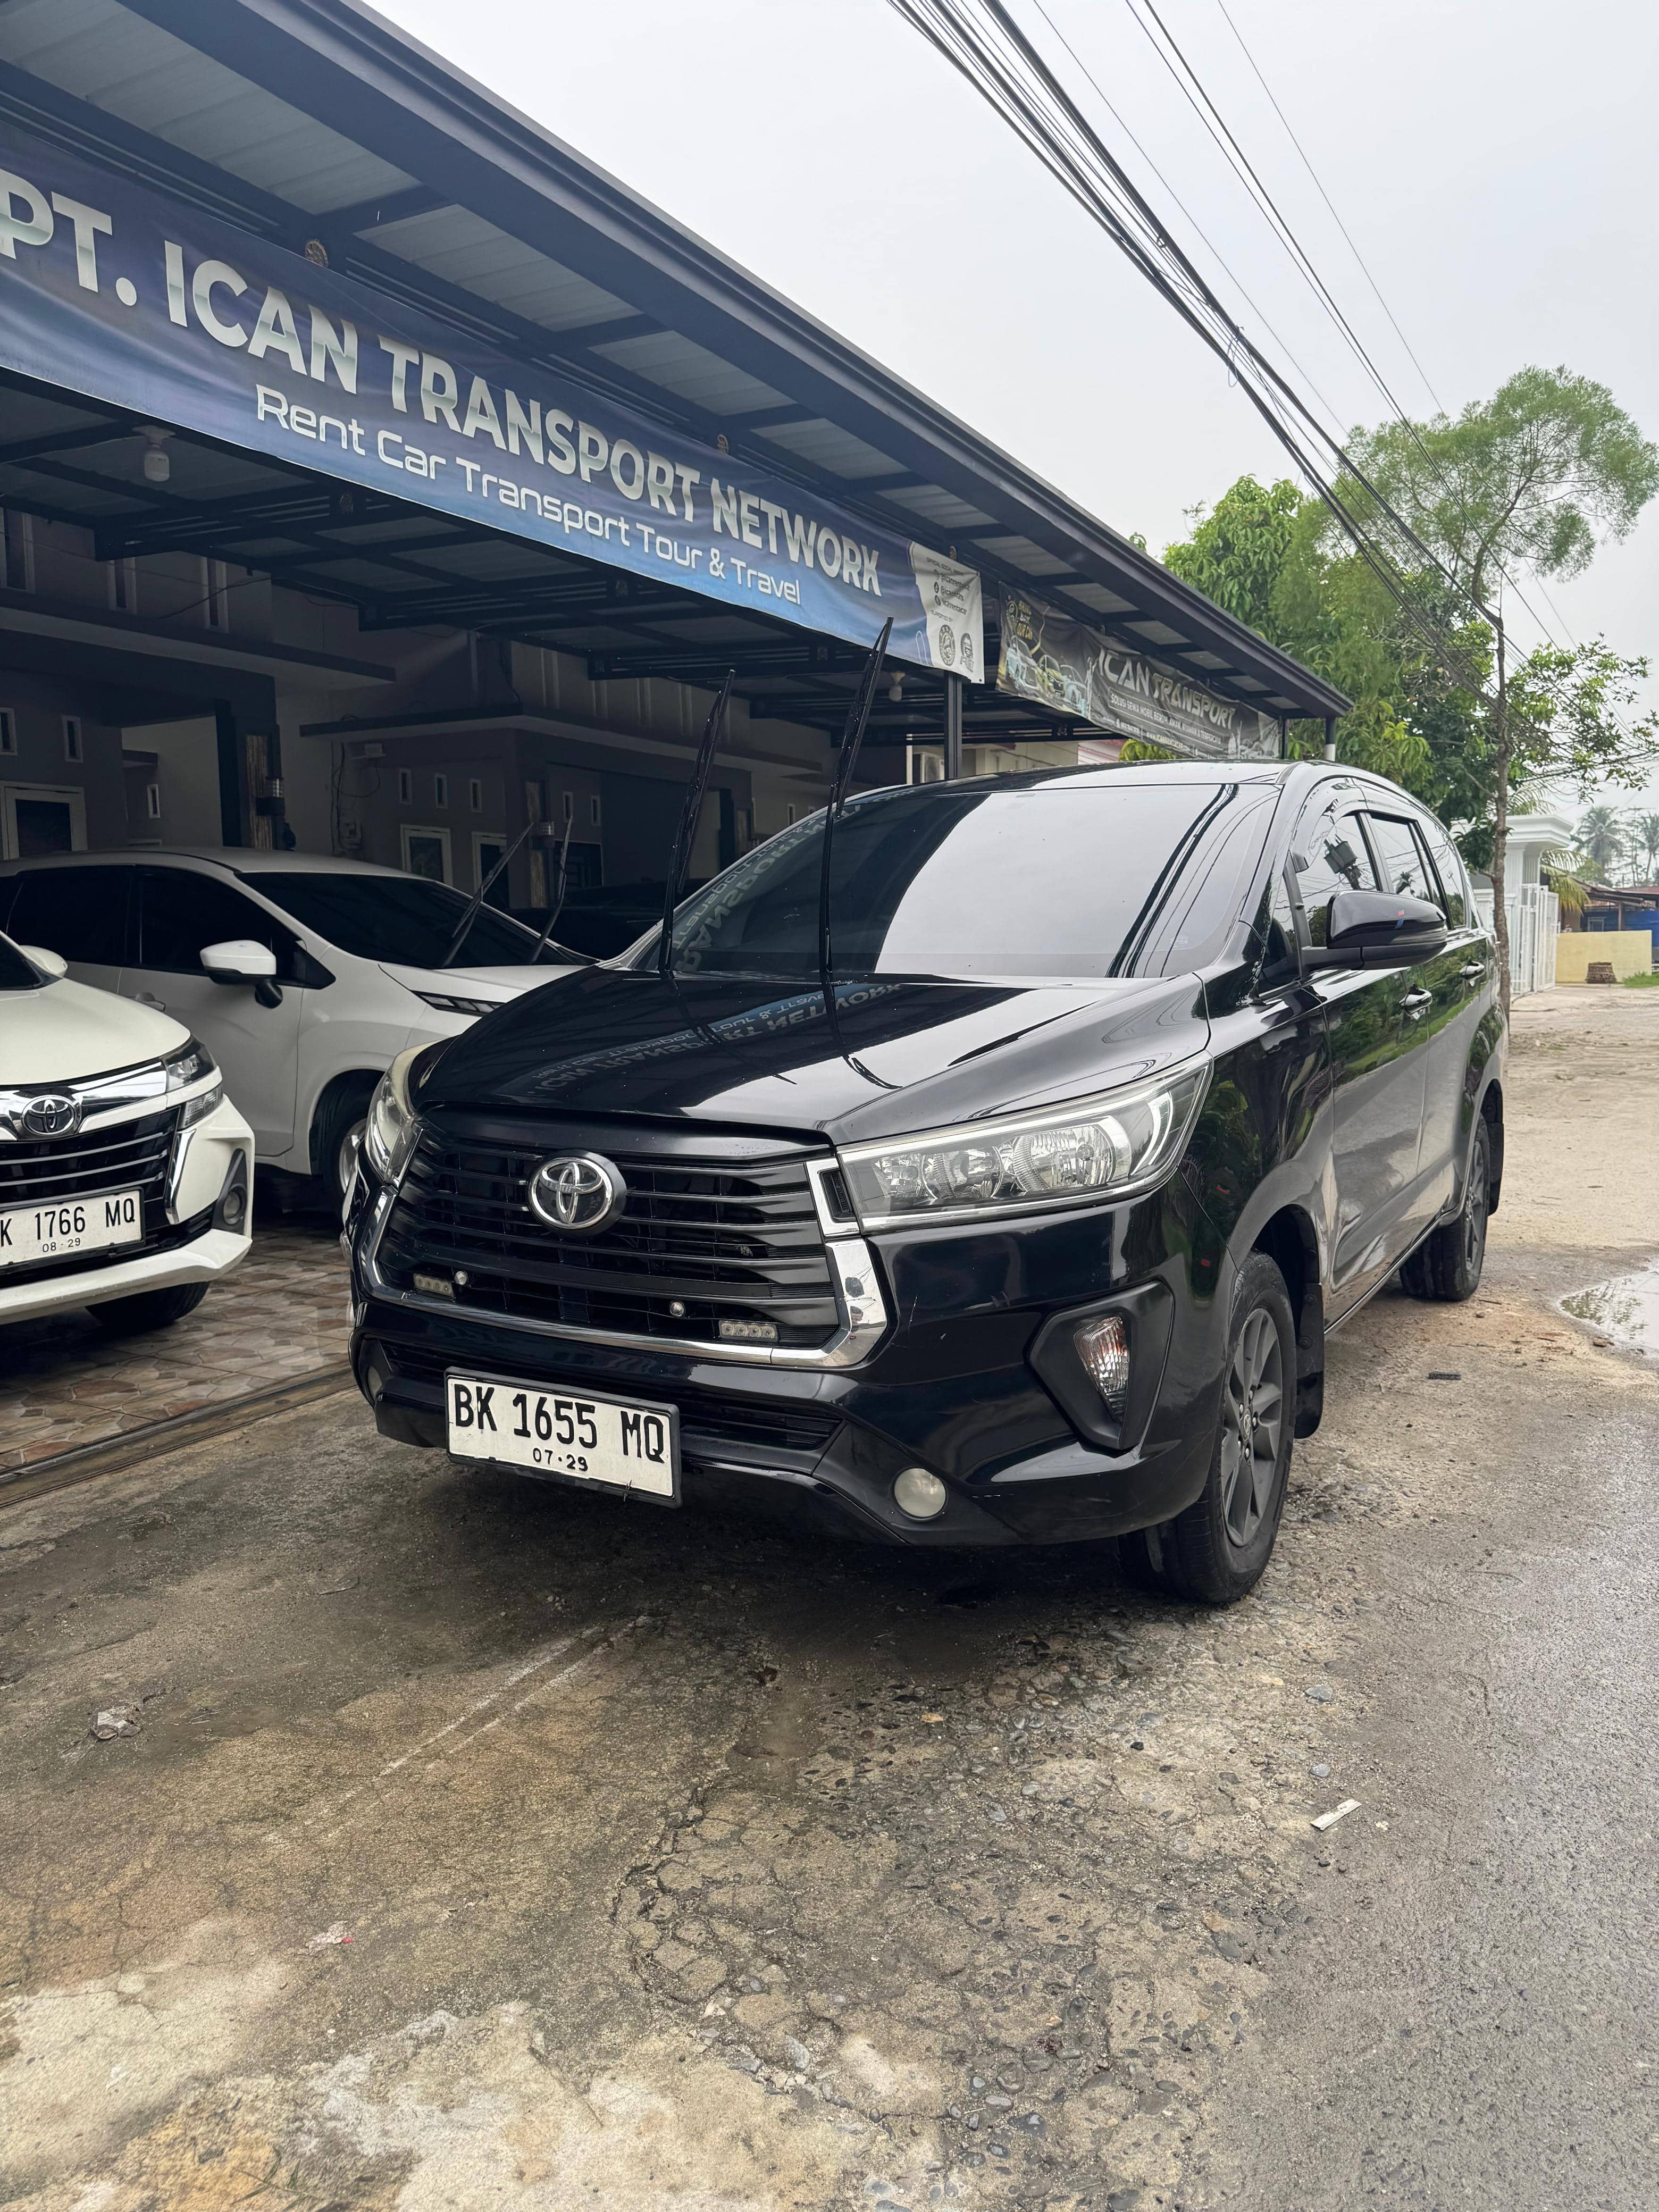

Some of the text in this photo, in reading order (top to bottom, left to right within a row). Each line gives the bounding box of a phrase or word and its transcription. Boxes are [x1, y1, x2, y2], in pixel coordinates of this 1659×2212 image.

[0, 169, 882, 597] PT. ICAN TRANSPORT NETWORK
[256, 384, 801, 605] Rent Car Transport Tour & Travel
[1099, 644, 1236, 730] ICAN TRANSPORT
[0, 1197, 136, 1247] K 1766 MQ
[454, 1383, 665, 1464] BK 1655 MQ
